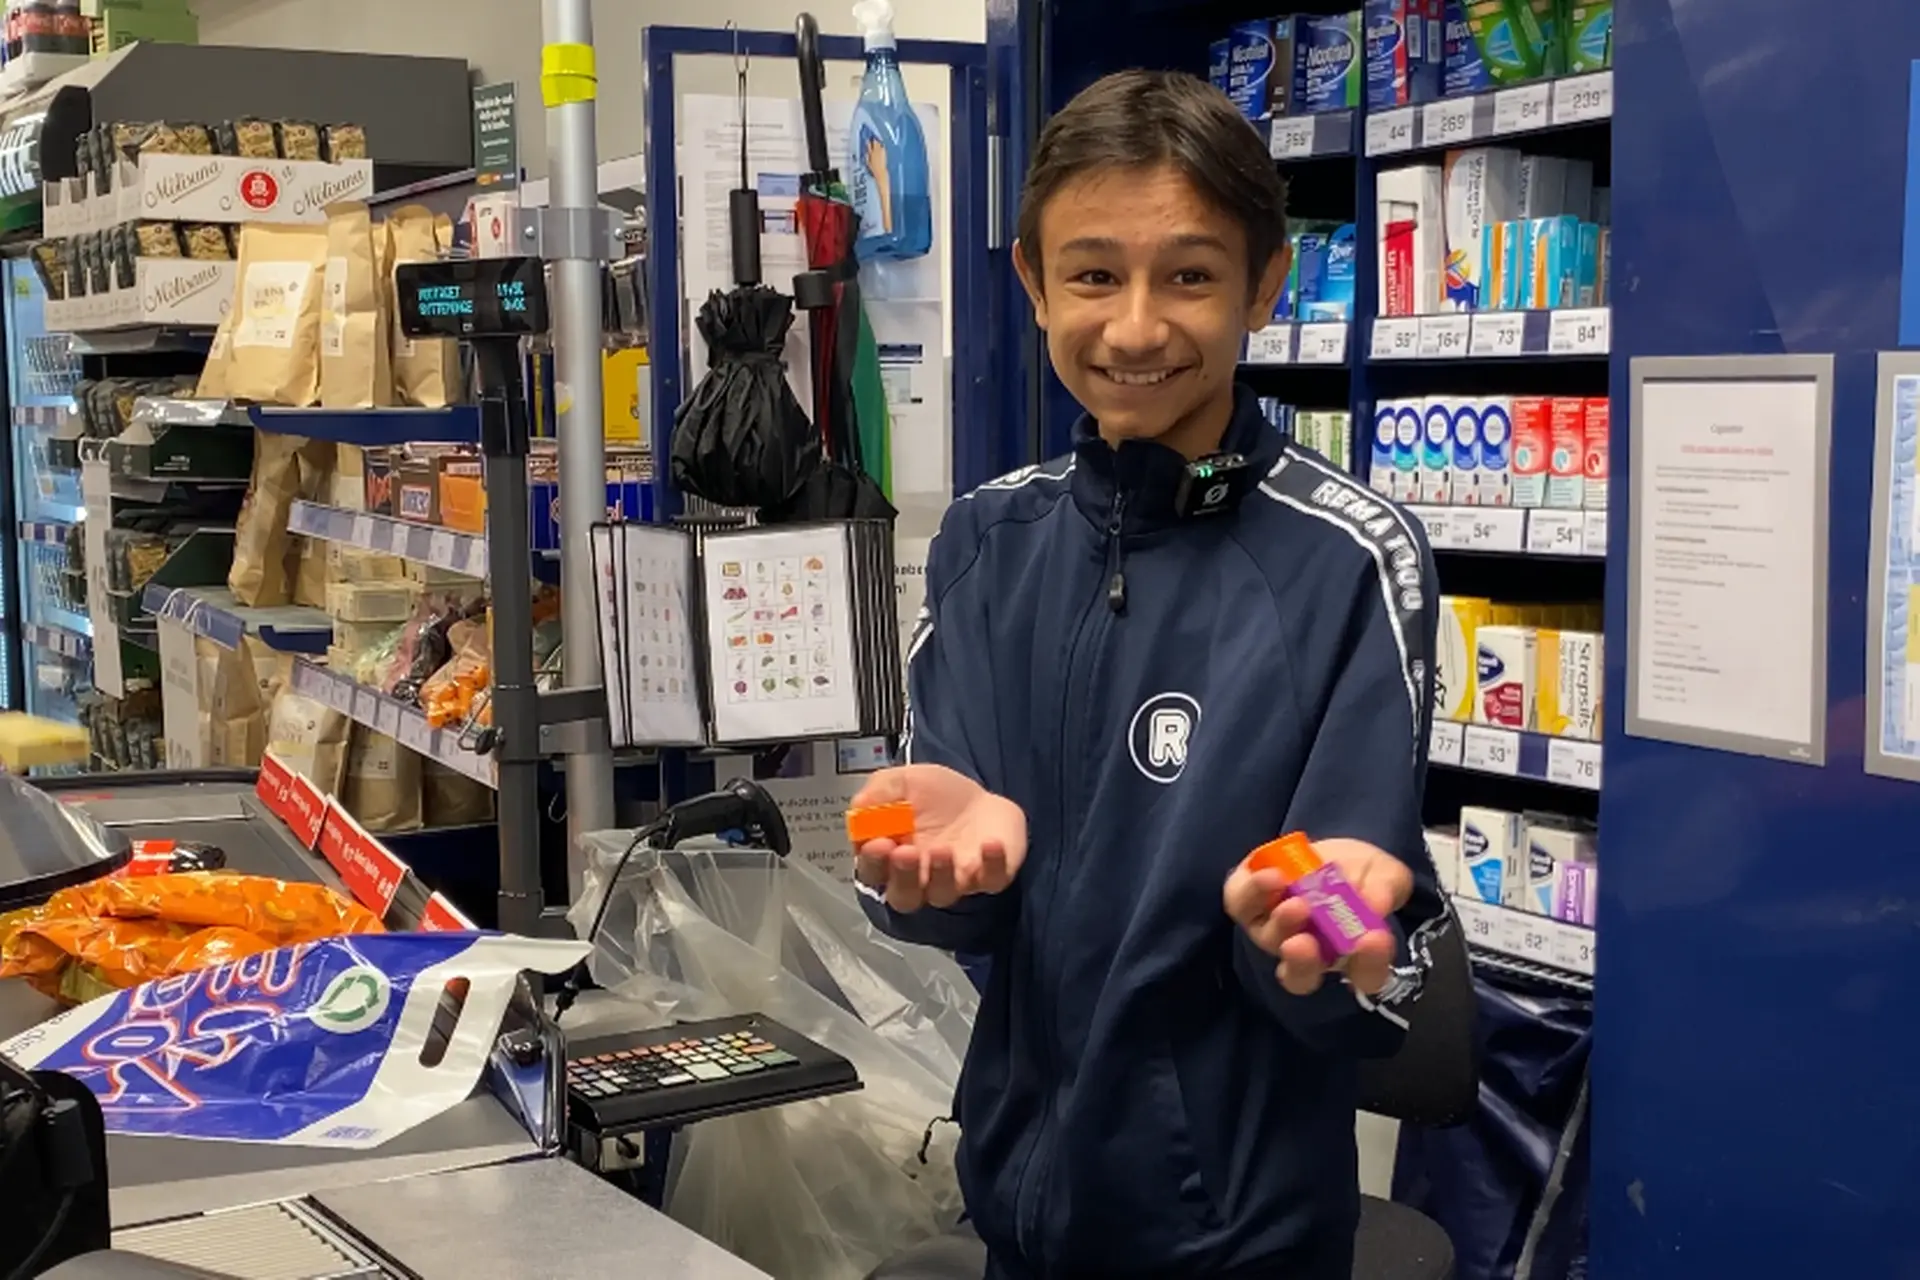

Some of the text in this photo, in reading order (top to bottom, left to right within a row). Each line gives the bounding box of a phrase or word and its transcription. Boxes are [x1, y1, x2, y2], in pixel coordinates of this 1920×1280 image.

[1311, 479, 1397, 537] REMA
[1577, 642, 1591, 728] Strepsils
[1148, 708, 1191, 768] R
